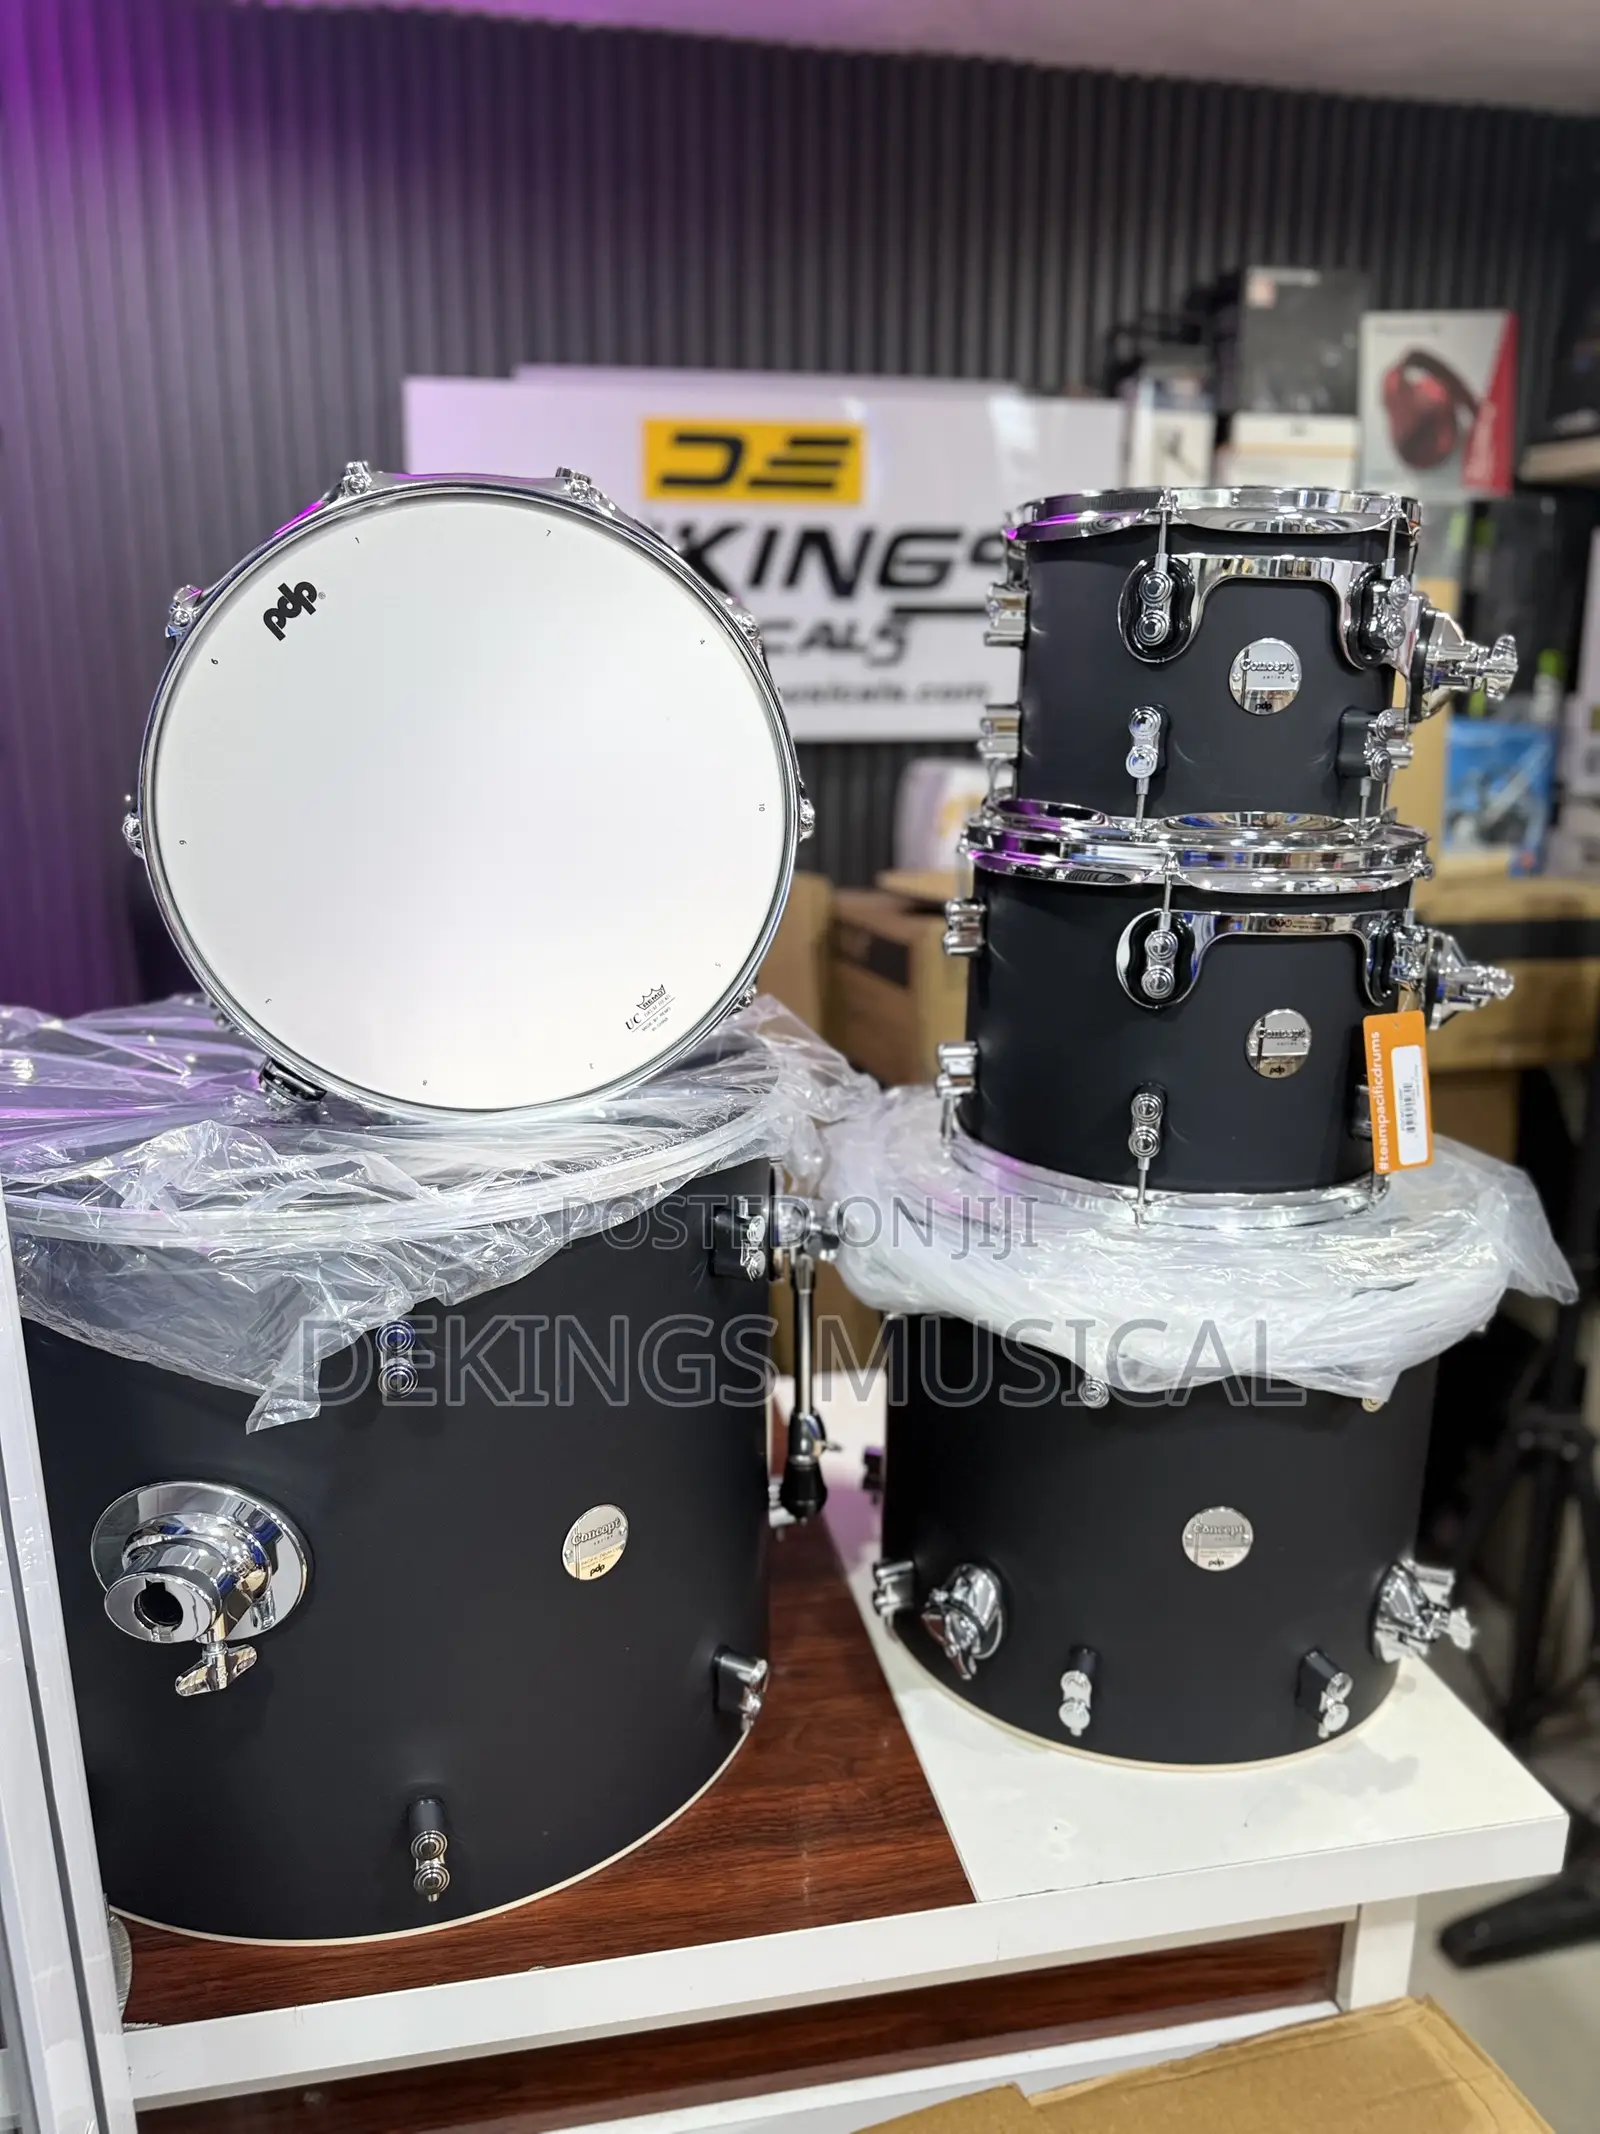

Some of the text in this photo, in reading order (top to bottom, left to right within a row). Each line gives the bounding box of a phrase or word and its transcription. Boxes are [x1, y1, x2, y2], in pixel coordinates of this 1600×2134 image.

[1240, 657, 1295, 675] Concept
[1255, 700, 1273, 712] pdp
[625, 1012, 642, 1031] UC
[1269, 1064, 1286, 1076] pdp
[1370, 1031, 1390, 1171] #teampacificdrums
[571, 1516, 622, 1546] Concept
[1192, 1522, 1246, 1538] Concept
[589, 1563, 605, 1577] pdp
[1208, 1558, 1225, 1568] pdp
